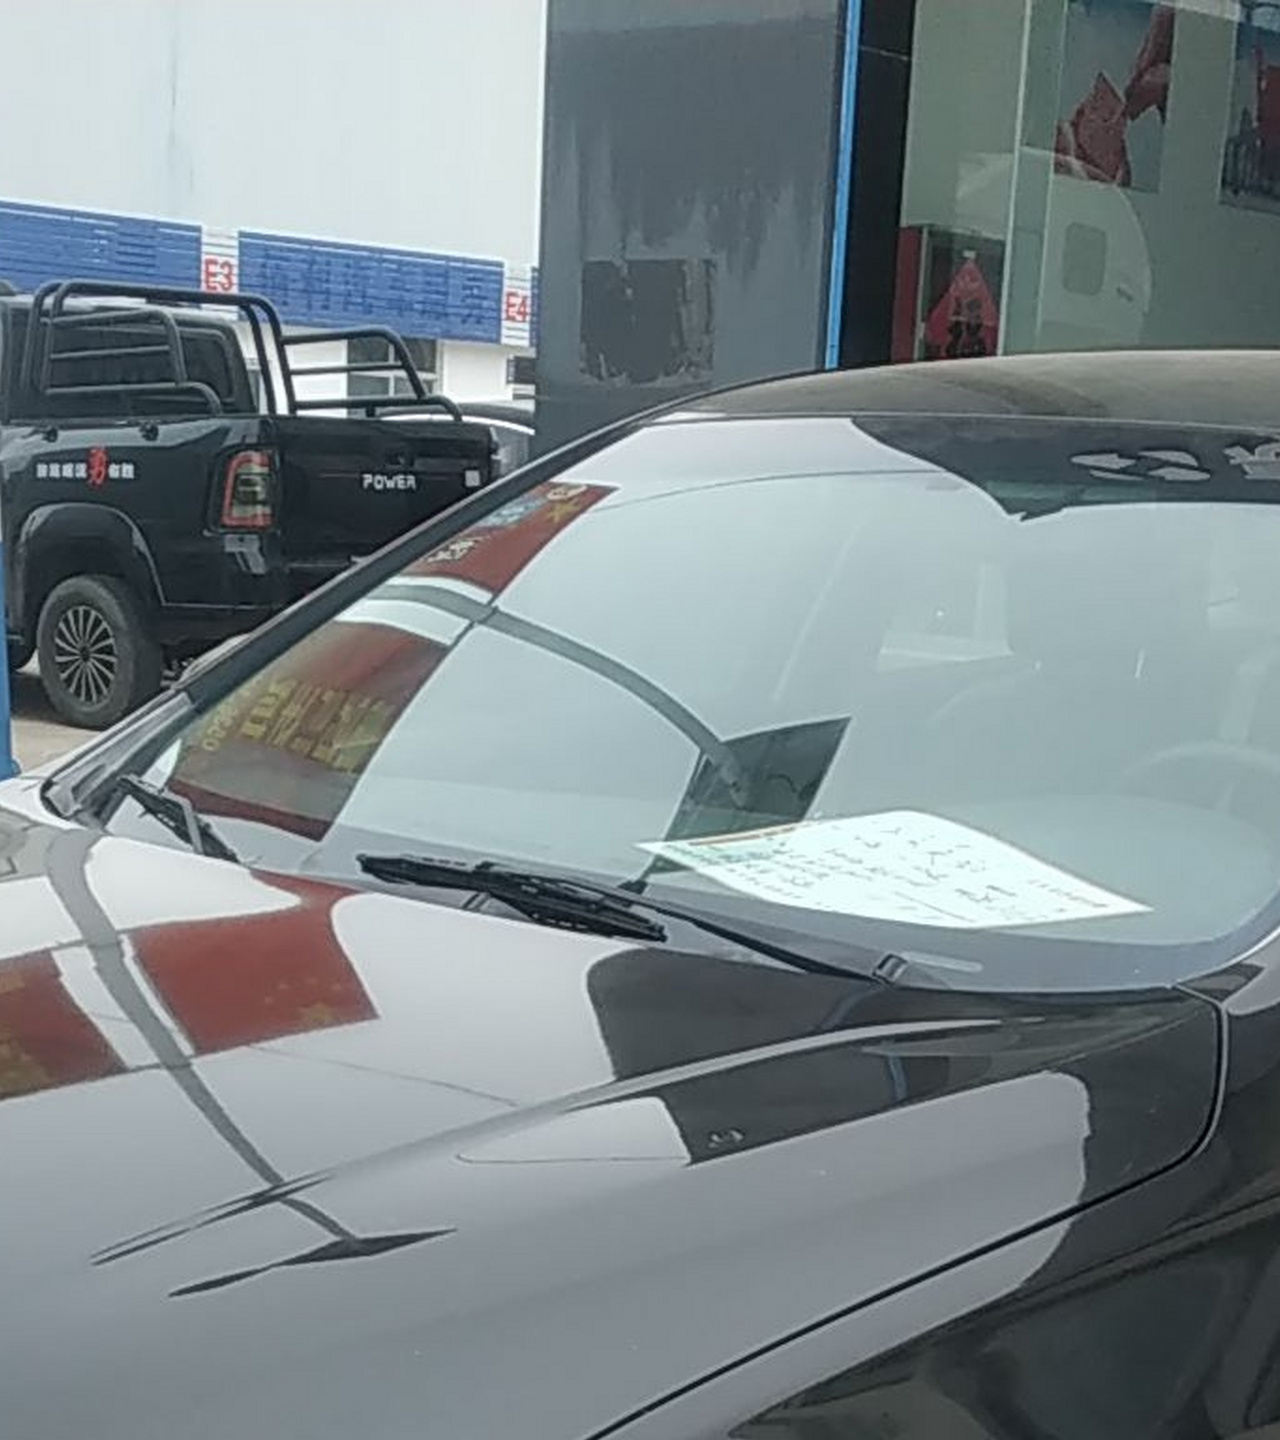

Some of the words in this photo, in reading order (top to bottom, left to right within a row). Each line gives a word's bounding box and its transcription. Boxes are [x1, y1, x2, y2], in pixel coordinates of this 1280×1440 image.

[205, 258, 233, 291] E3
[506, 291, 527, 322] E4
[362, 474, 417, 490] POWER
